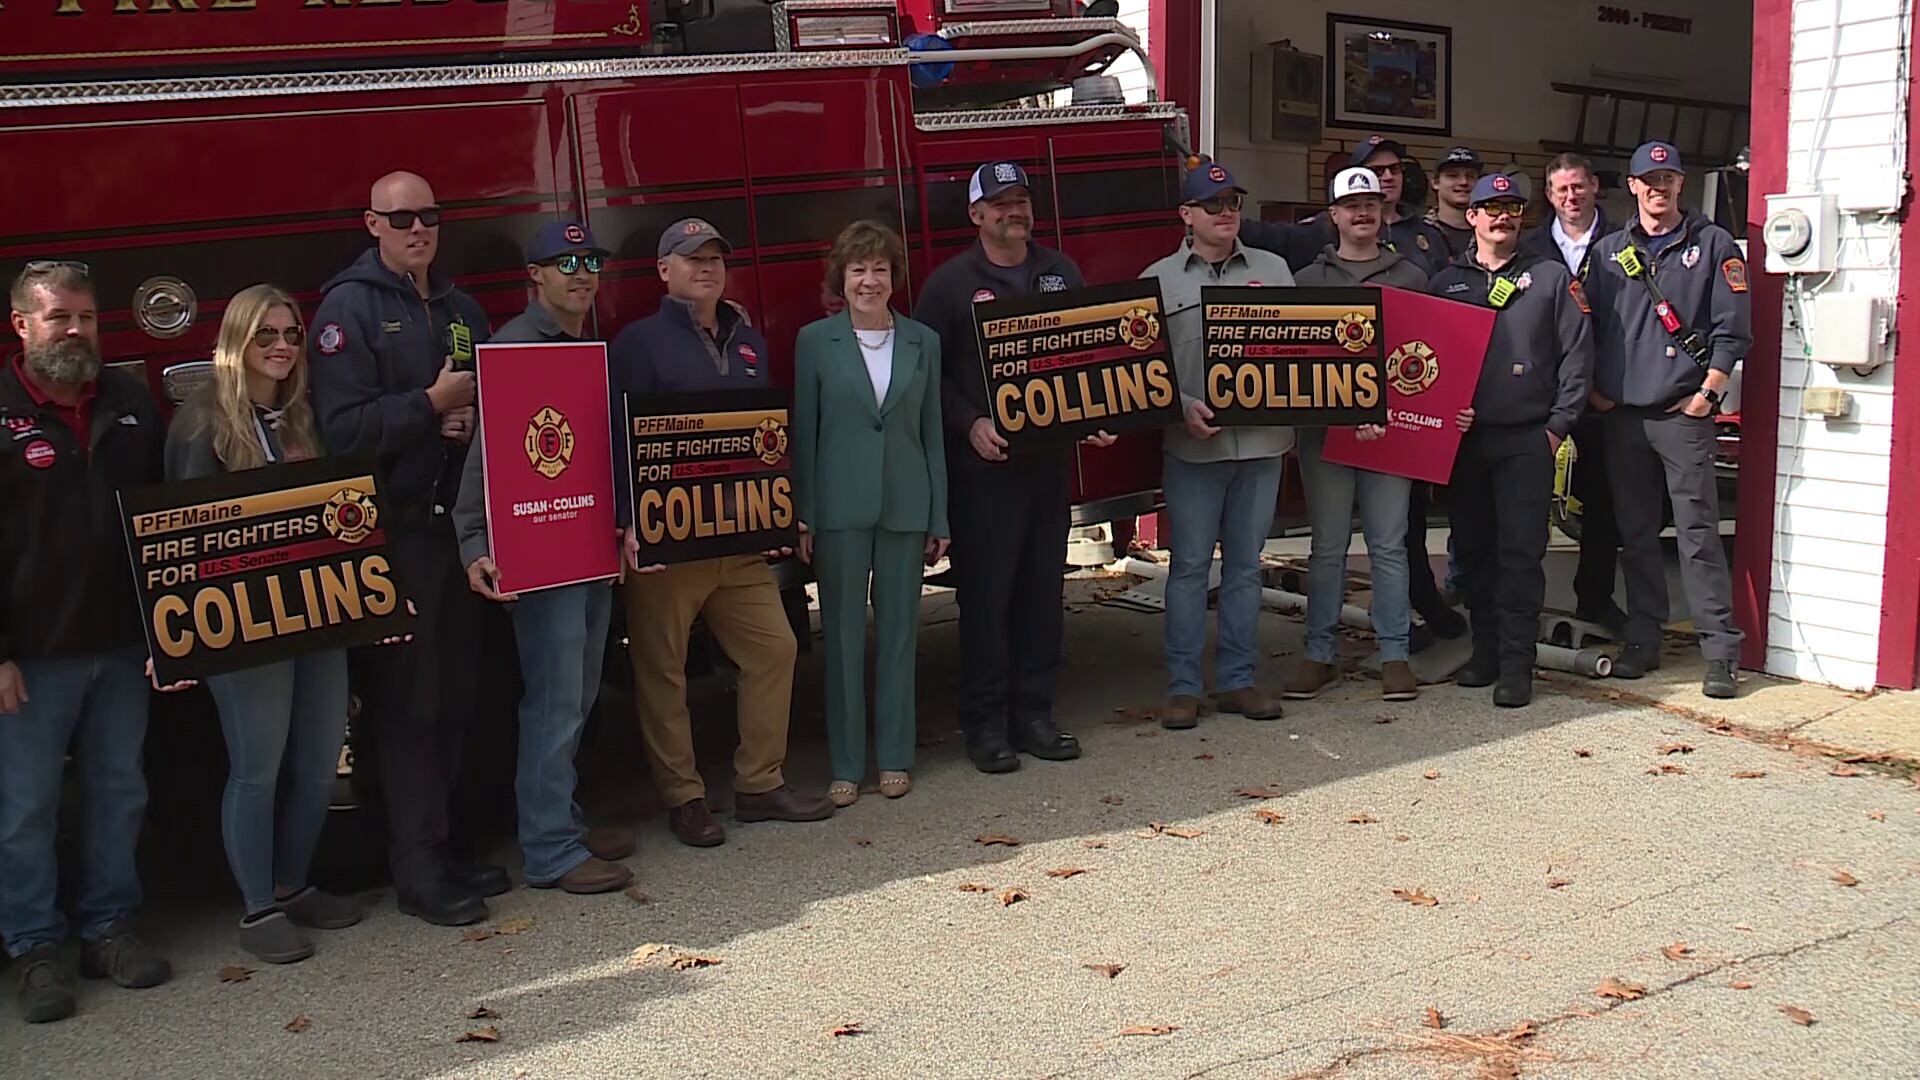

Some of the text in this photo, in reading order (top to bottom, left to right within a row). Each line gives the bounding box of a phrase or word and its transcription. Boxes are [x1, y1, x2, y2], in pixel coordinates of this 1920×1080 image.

[1209, 306, 1281, 319] PFFMaine
[988, 314, 1061, 335] PFFMaine
[1207, 326, 1332, 340] FIRE FIGHTERS
[989, 326, 1116, 360] FIRE FIGHTERS
[1207, 344, 1243, 358] FOR
[992, 360, 1028, 379] FOR
[996, 359, 1173, 432] COLLINS
[1207, 362, 1379, 409] COLLINS
[638, 417, 704, 433] PFFMaine
[1398, 410, 1443, 428] COLLINS
[637, 436, 751, 460] FIRE FIGHTERS
[638, 464, 671, 483] FOR
[513, 495, 595, 516] SUSAN COLLINS
[639, 476, 793, 544] COLLINS
[140, 504, 242, 533] PFFMaine
[533, 510, 578, 524] our senator
[142, 514, 319, 564] FIRE FIGHTERS
[147, 550, 290, 590] FOR U.S. Senate
[153, 555, 397, 658] COLLINS
